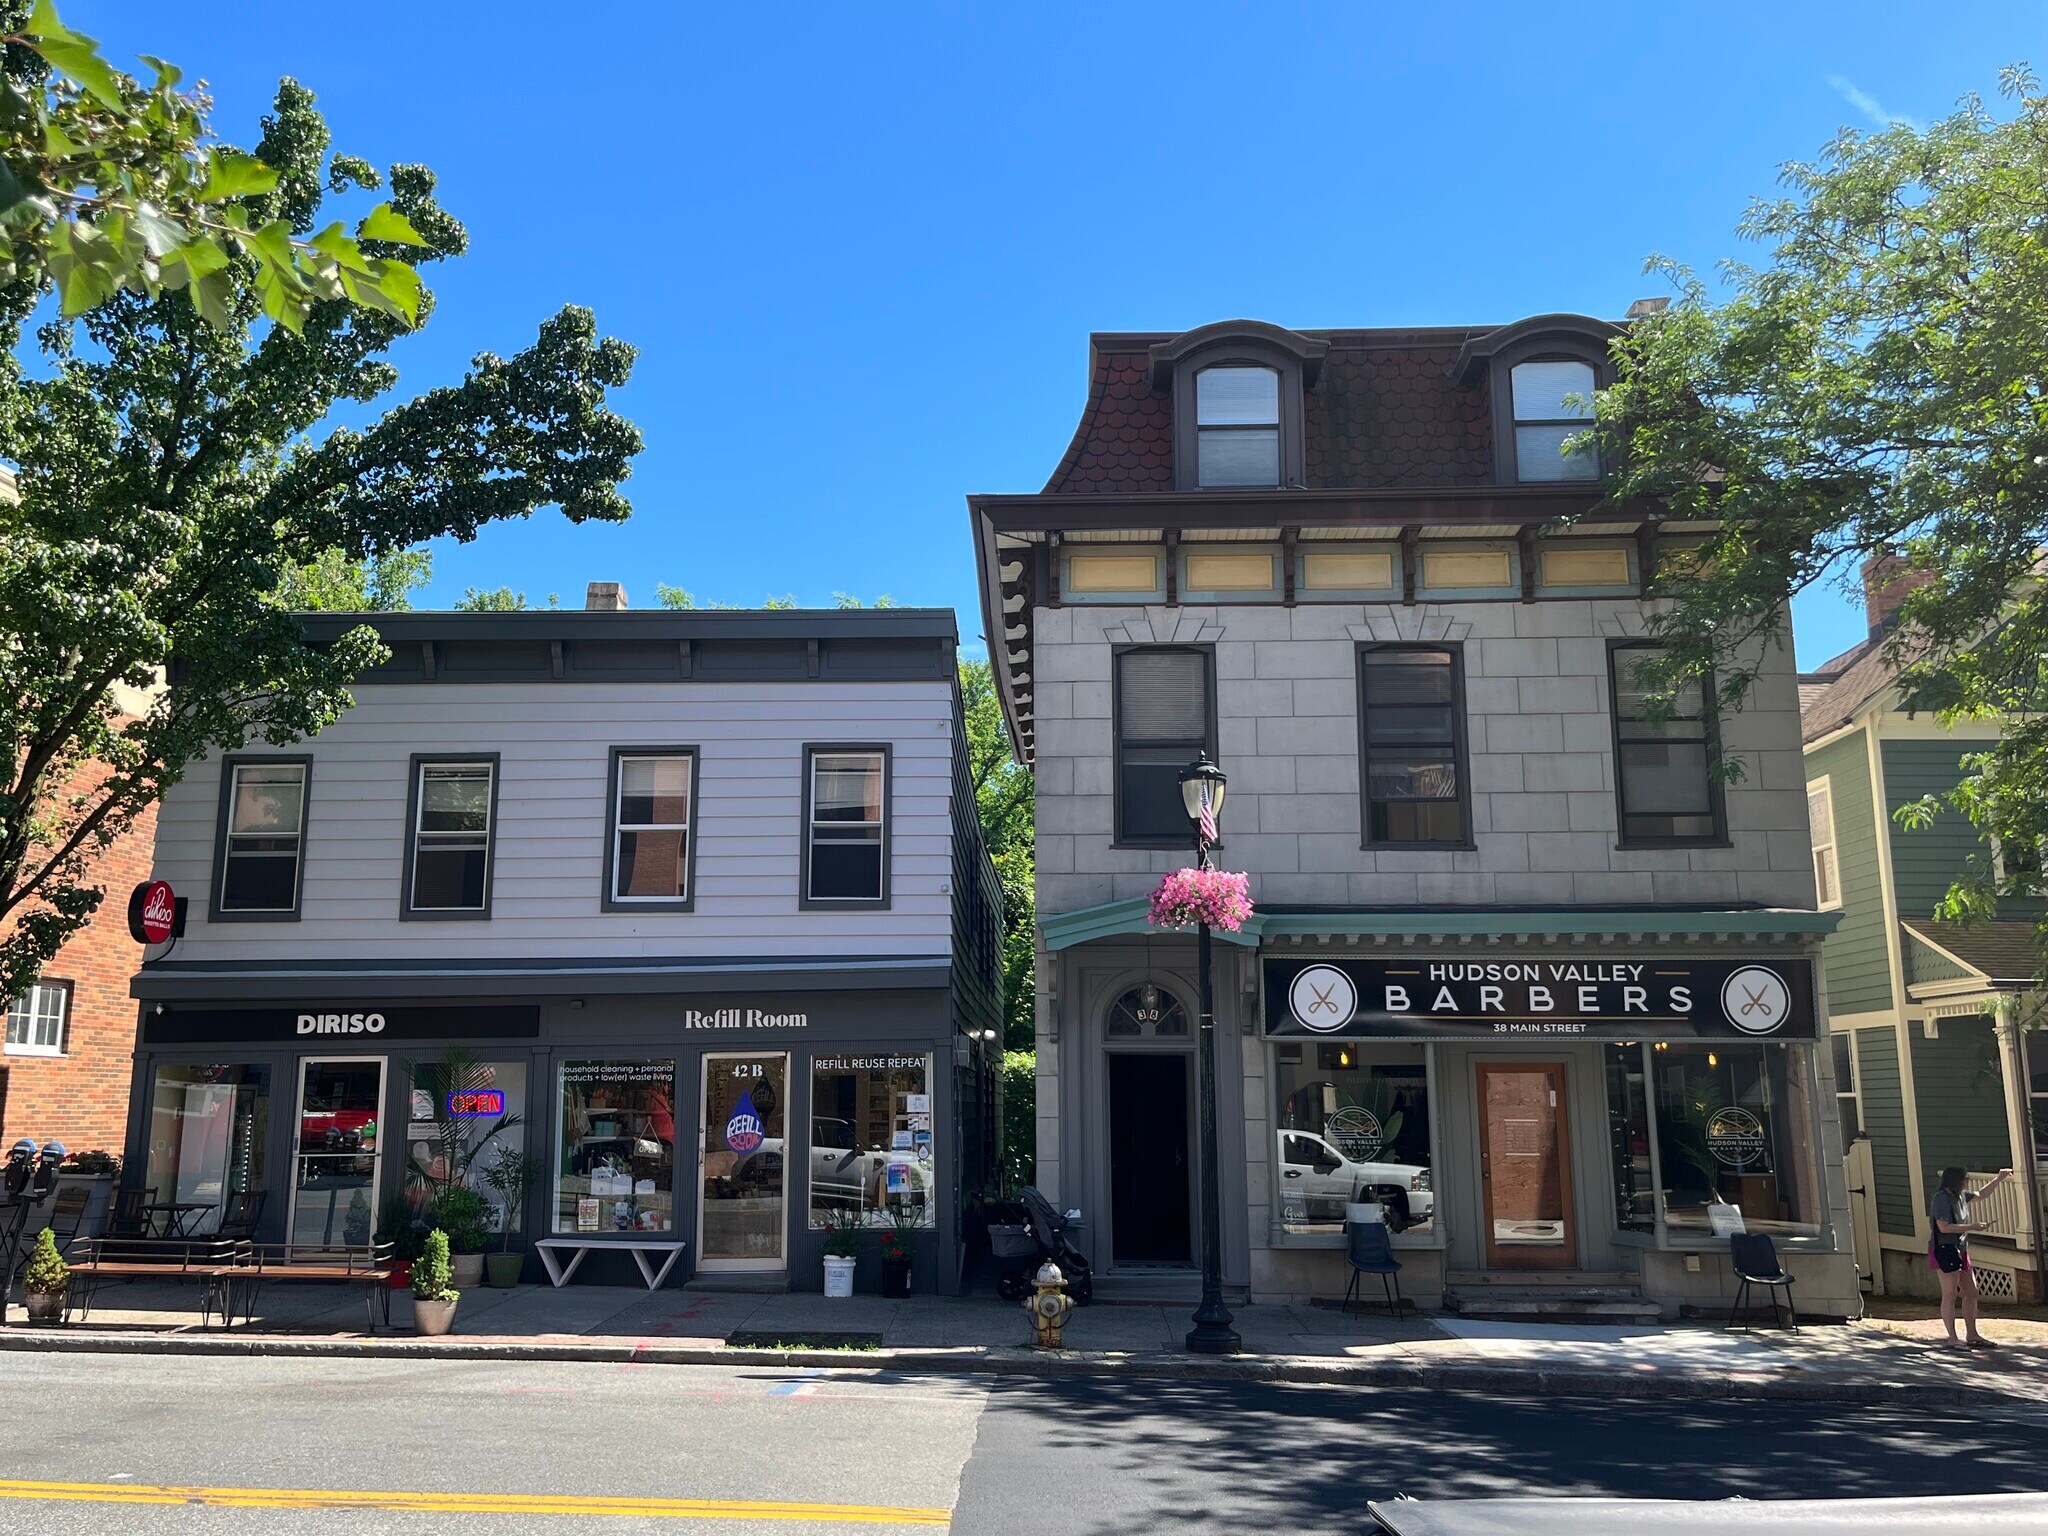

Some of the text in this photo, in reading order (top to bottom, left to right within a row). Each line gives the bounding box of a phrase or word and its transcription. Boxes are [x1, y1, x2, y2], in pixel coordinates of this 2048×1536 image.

[1429, 963, 1644, 982] HUDSON VALLEY
[1385, 985, 1693, 1013] BARBERS
[296, 1013, 386, 1034] DIRISO
[685, 1008, 808, 1029] Refill Room
[1493, 1023, 1587, 1033] 38 MAIN STREET
[560, 1065, 599, 1073] household
[600, 1065, 634, 1073] cleaning
[641, 1065, 674, 1074] personal
[731, 1064, 763, 1077] 42 B
[815, 1057, 927, 1070] REFILL REUSE REPEAT
[559, 1074, 593, 1083] products
[601, 1073, 628, 1082] low(er)
[653, 1073, 673, 1082] living
[451, 1094, 501, 1114] OPEN
[726, 1114, 762, 1139] REFILL
[727, 1133, 760, 1151] ROOM
